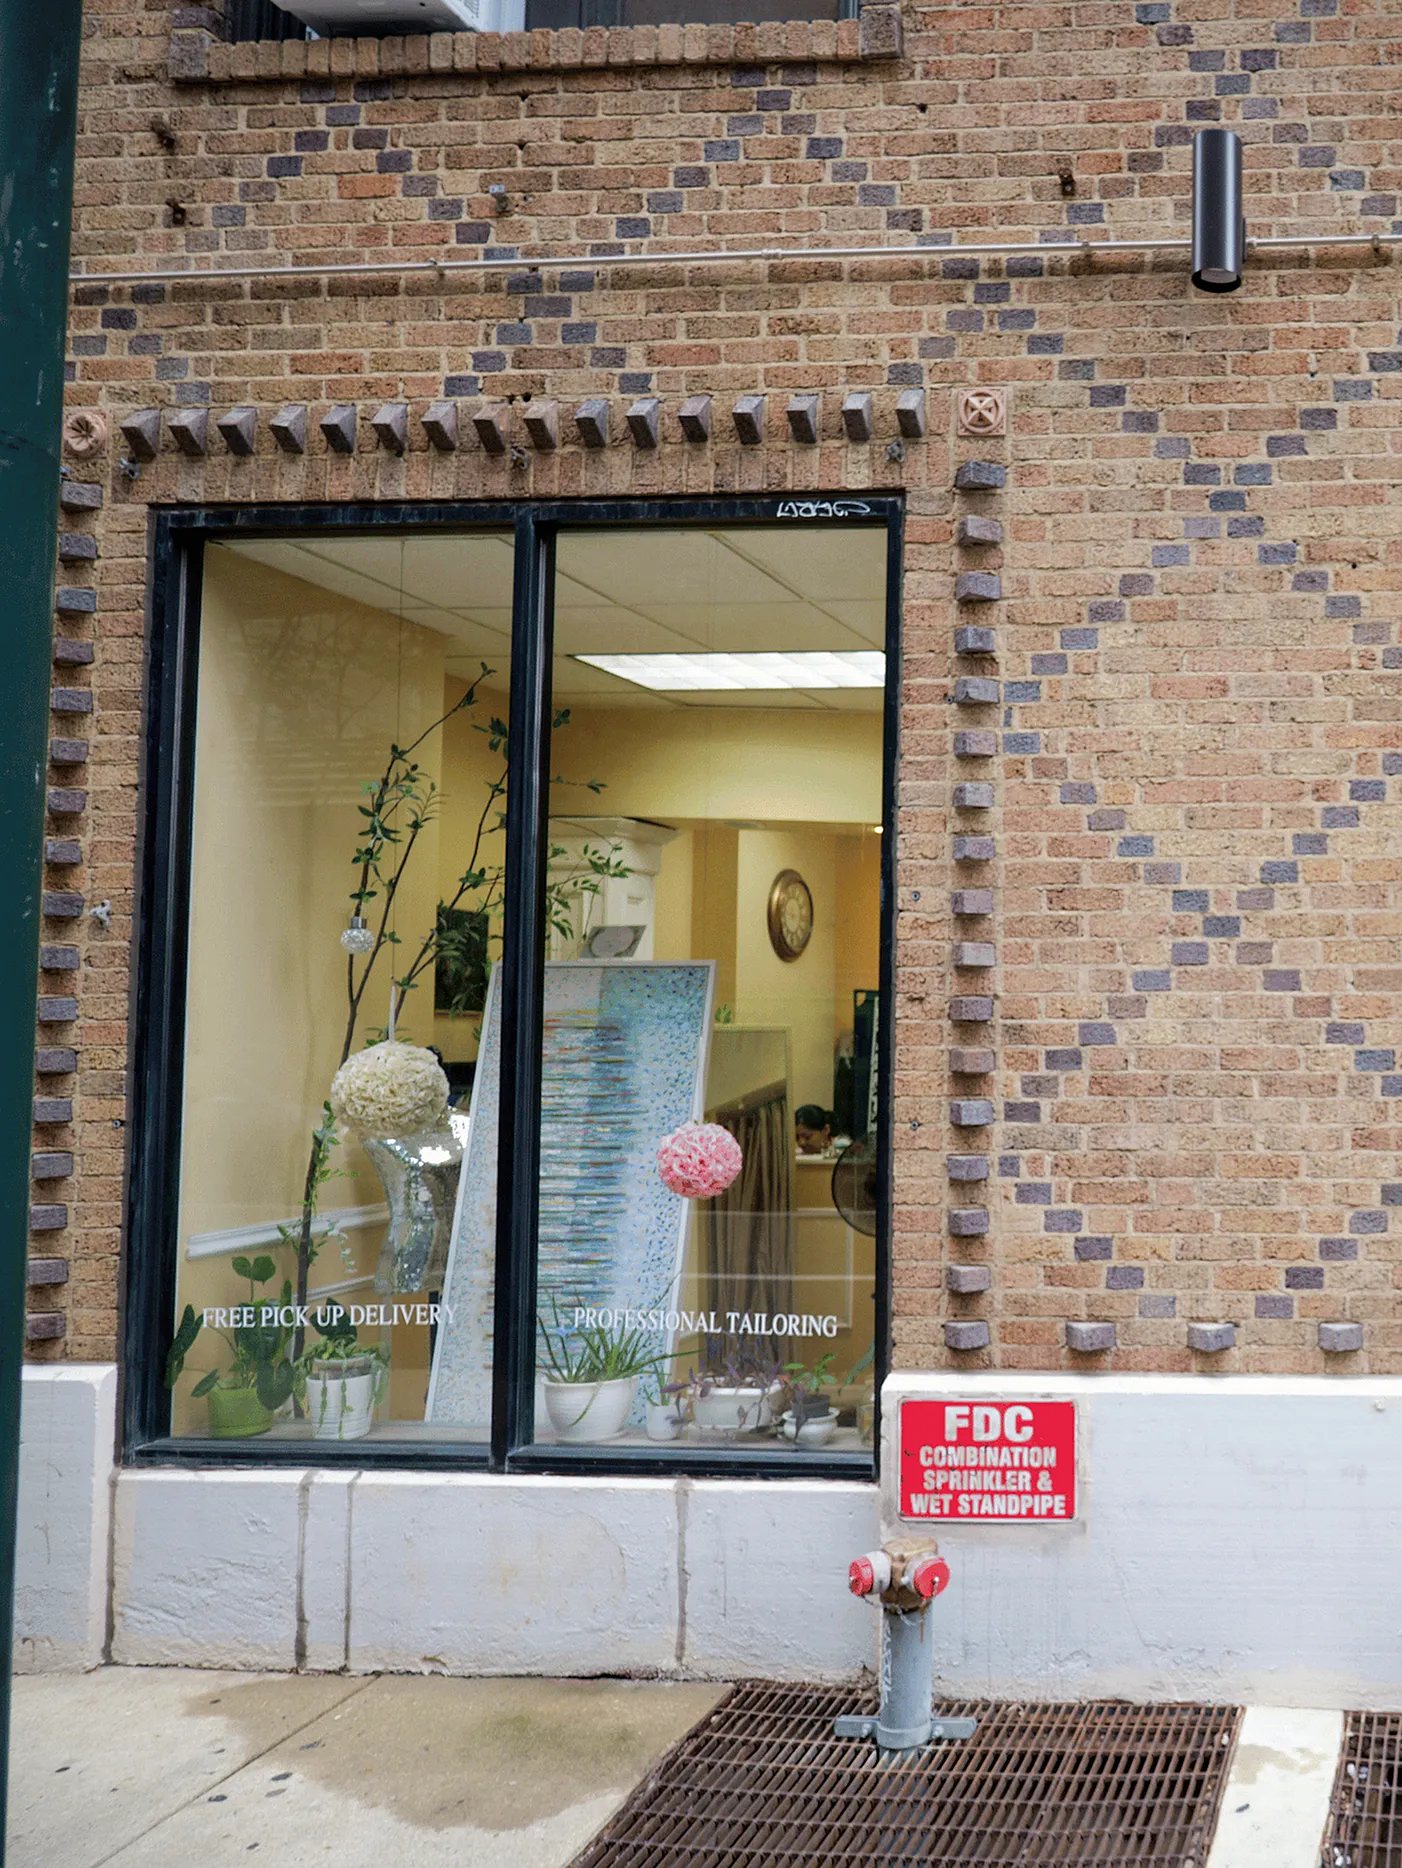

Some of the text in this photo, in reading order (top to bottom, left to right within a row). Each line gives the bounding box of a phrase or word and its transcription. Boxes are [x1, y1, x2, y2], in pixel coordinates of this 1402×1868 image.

[202, 1304, 459, 1328] FREE PICK UP DELIVERY
[574, 1306, 838, 1337] PROFESSIONAL TAILORING
[944, 1405, 1034, 1442] FDC
[919, 1445, 1057, 1467] COMBINATION
[923, 1470, 1053, 1492] SPRINKLER &
[910, 1494, 1066, 1516] WET STANDPIPE
